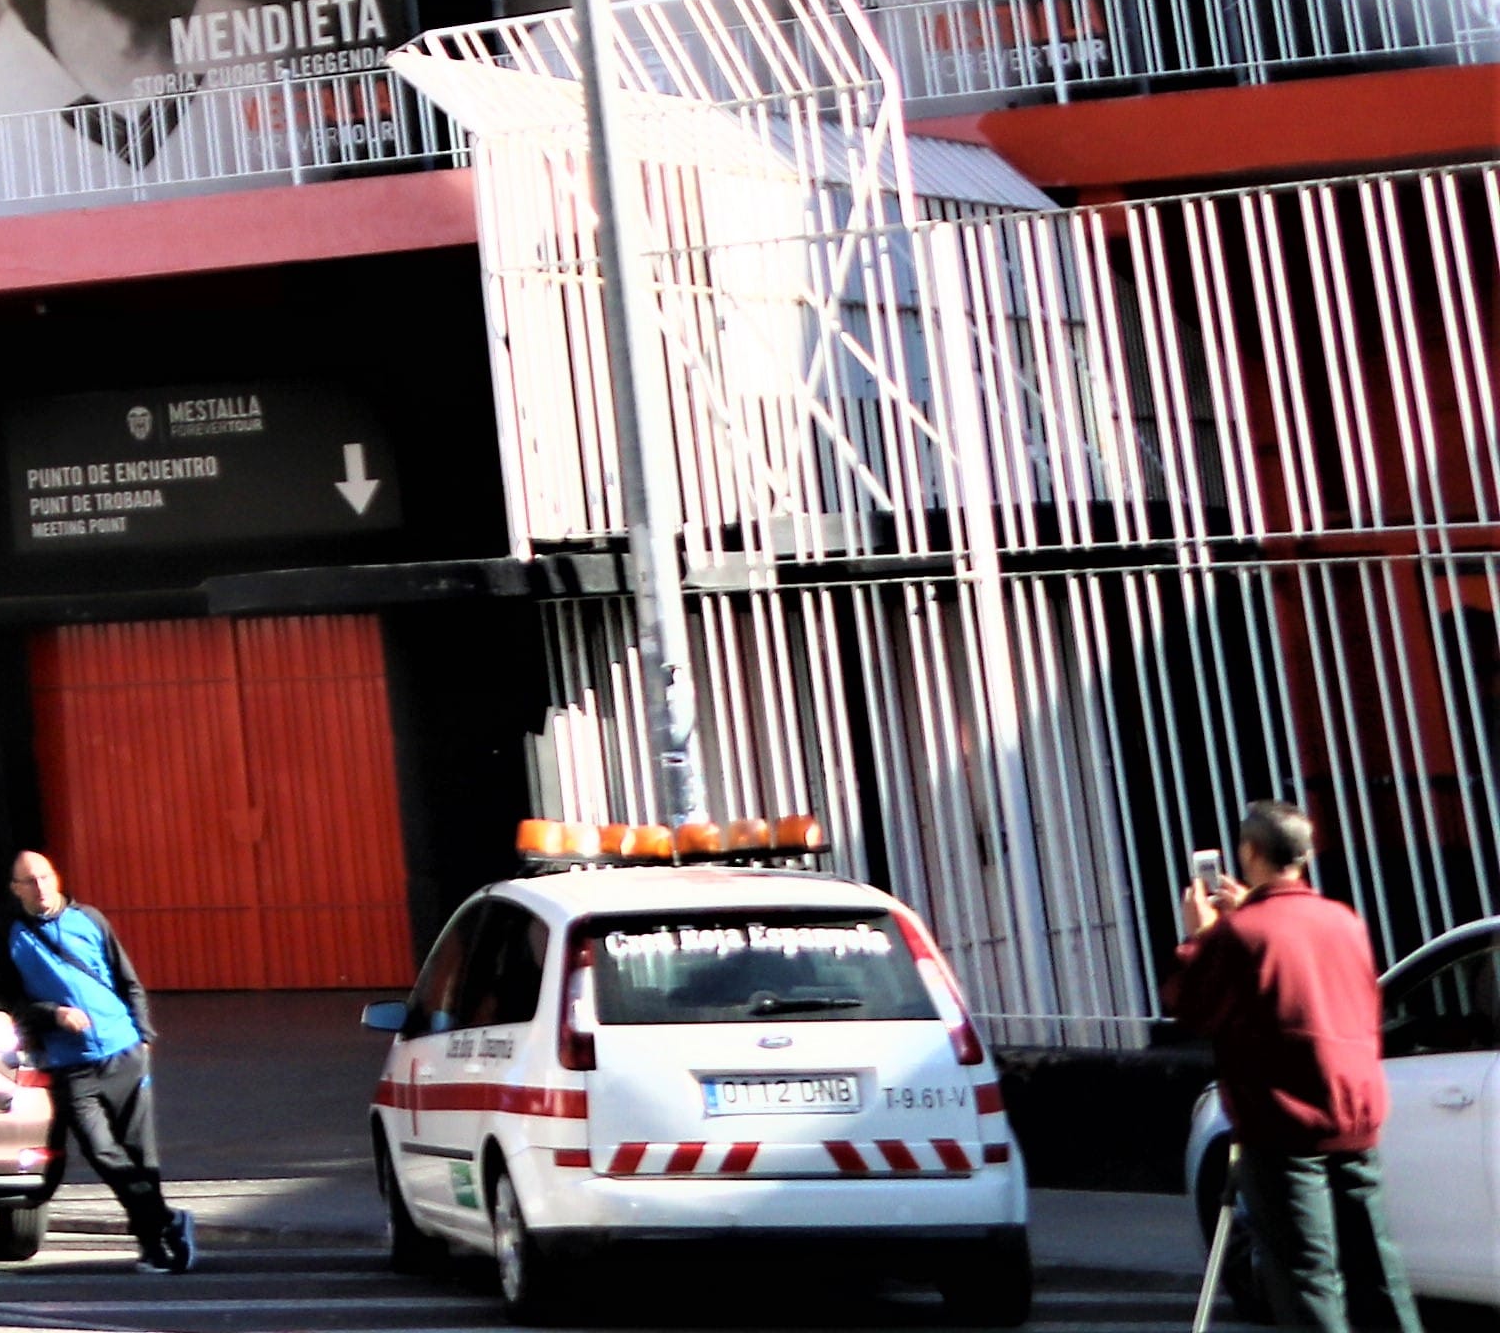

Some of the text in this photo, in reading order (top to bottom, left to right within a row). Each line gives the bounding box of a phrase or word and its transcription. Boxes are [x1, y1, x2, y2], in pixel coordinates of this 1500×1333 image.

[207, 61, 269, 88] CUORE
[290, 45, 387, 79] LEGGENDA
[168, 394, 263, 423] MESTALLA
[27, 455, 219, 490] PUNTO DE ENCUENTRO
[30, 489, 165, 517] PUNT DE TROBADA
[88, 516, 128, 535] POINT
